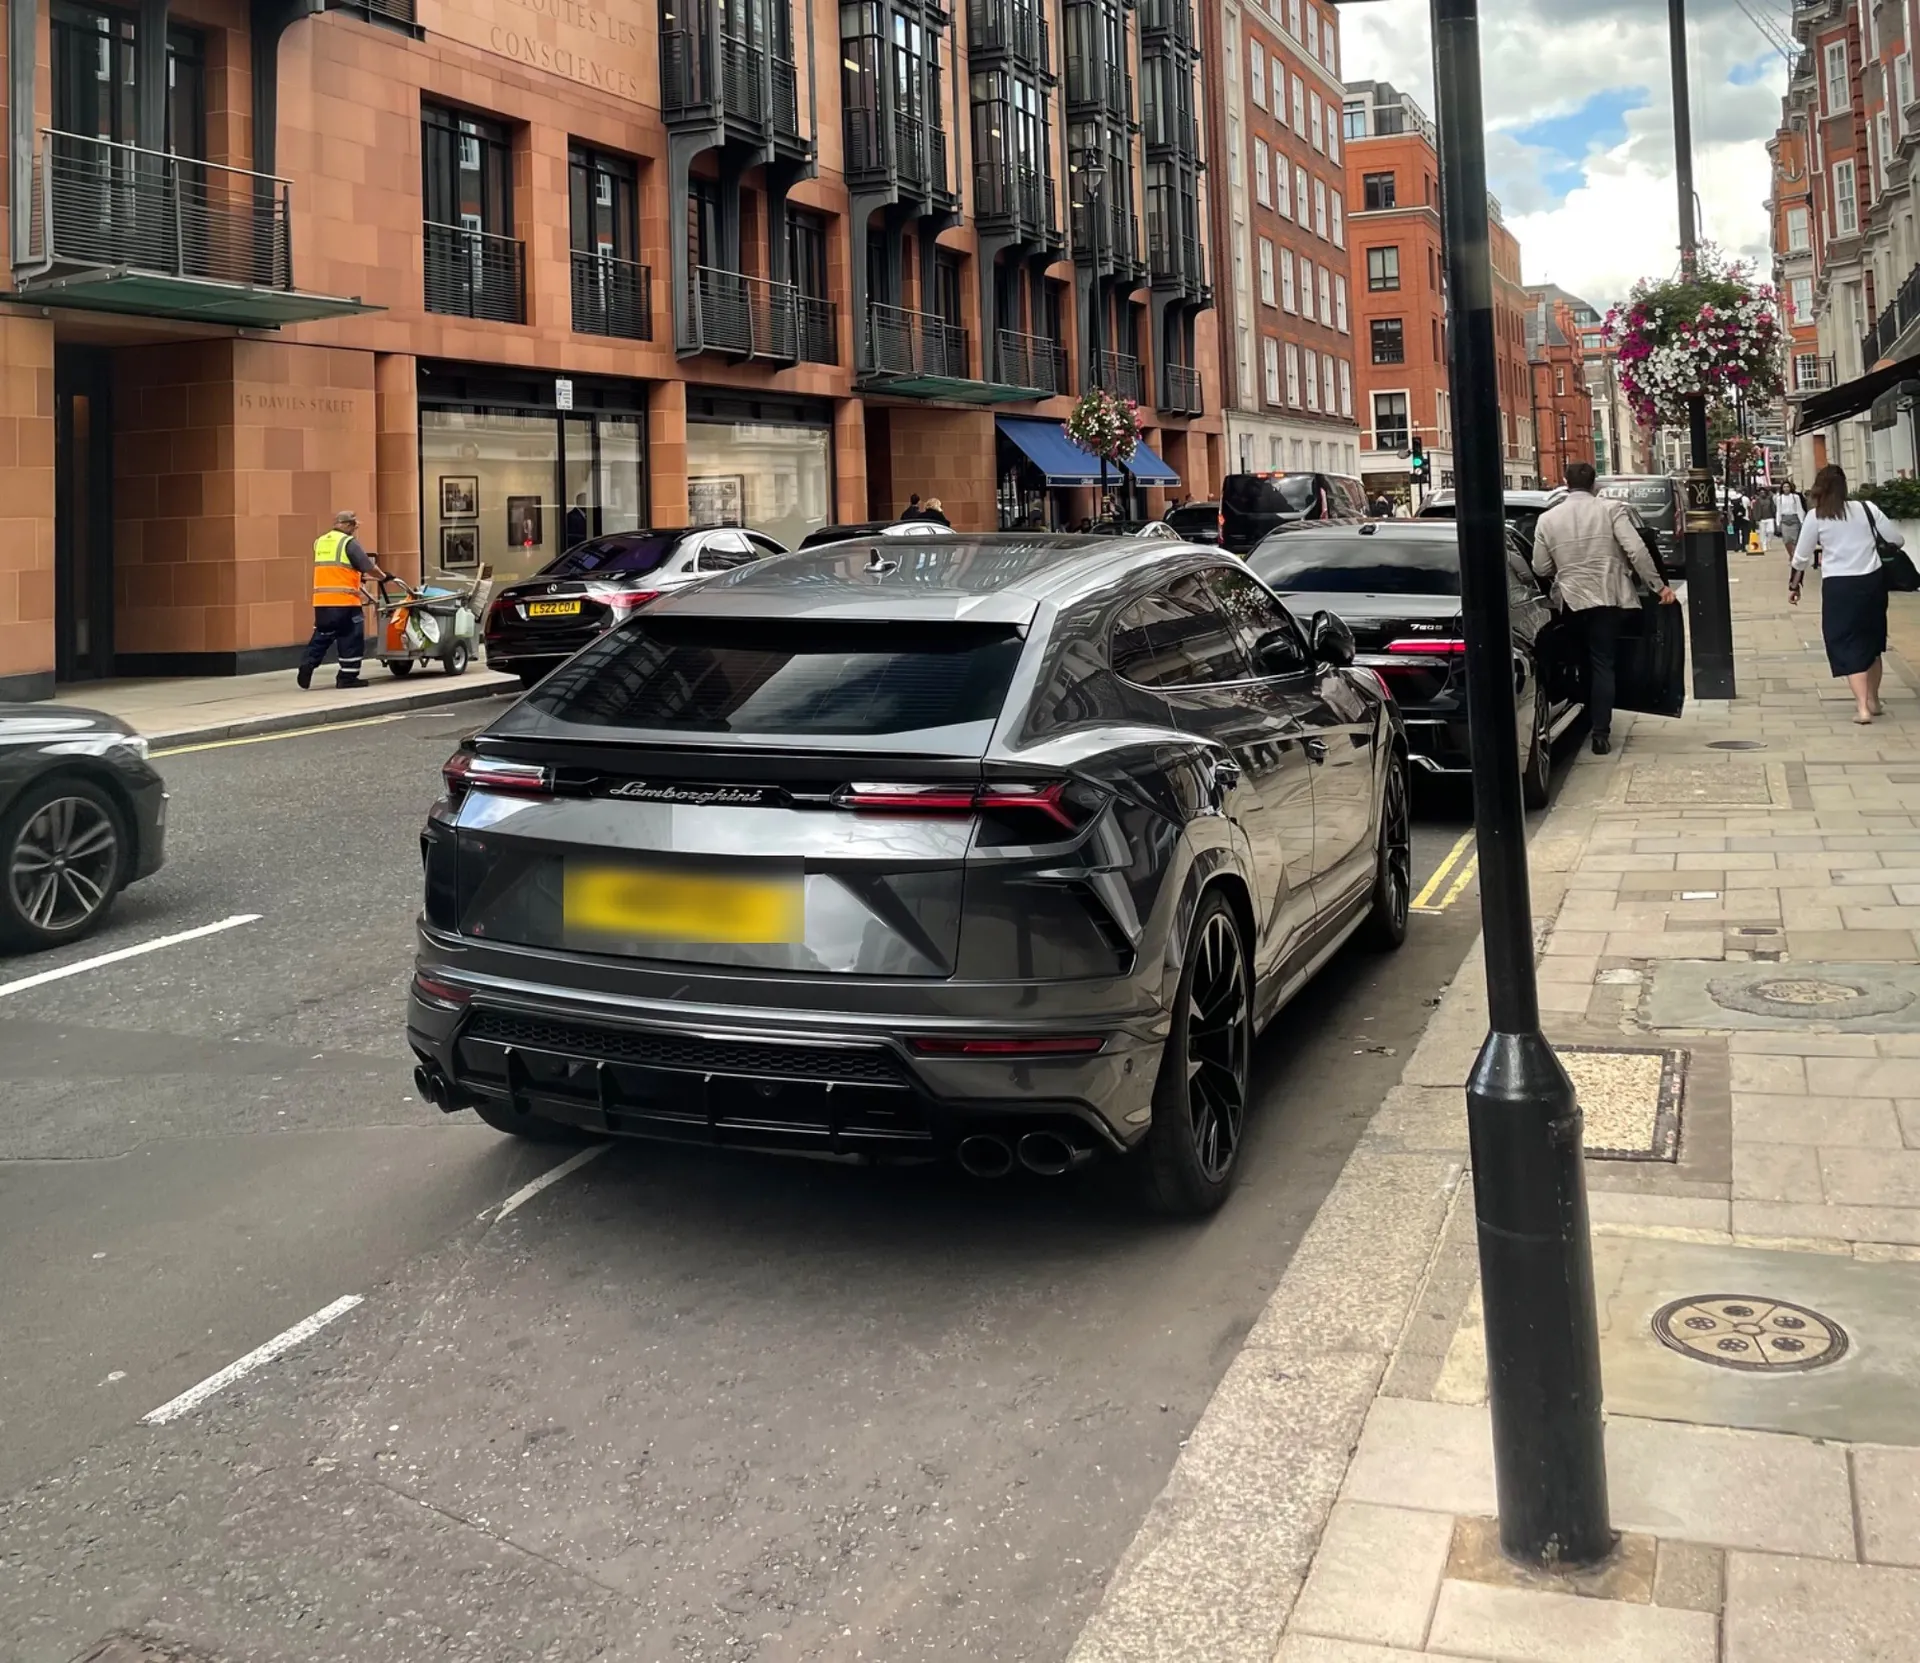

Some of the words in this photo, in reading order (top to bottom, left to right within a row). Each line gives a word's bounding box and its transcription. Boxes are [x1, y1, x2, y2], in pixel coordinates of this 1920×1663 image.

[522, 0, 598, 32] UTES
[608, 17, 636, 48] LES
[490, 26, 637, 98] CONSCIENCES
[240, 394, 252, 410] 15
[259, 395, 306, 410] DAVIES
[309, 398, 355, 413] STREET
[533, 604, 557, 614] LS22
[609, 781, 762, 803] Lamborghini
